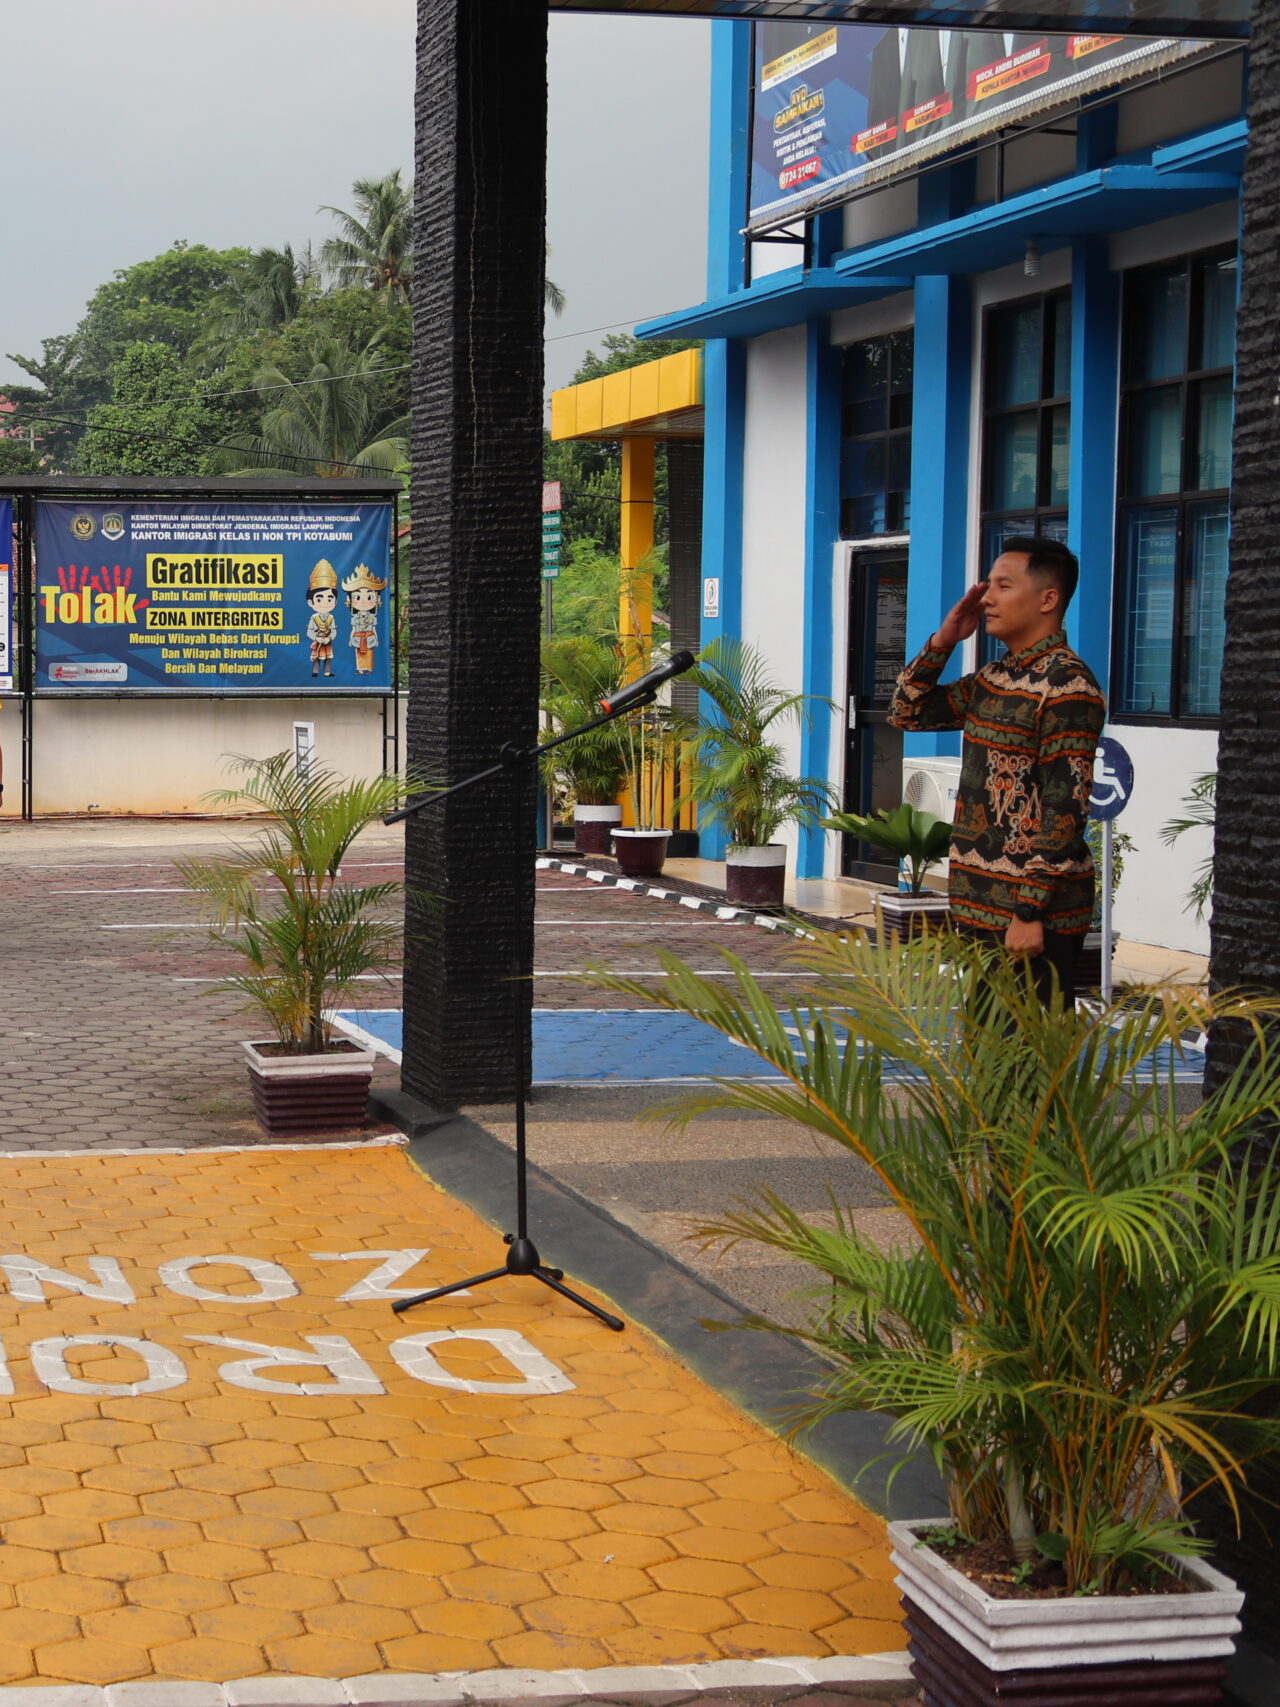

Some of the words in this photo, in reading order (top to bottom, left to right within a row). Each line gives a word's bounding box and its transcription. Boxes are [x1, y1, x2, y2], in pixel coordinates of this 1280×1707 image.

[791, 88, 807, 105] AYO
[781, 168, 797, 185] 0724
[131, 531, 172, 540] KANTOR
[173, 531, 217, 540] IMIGRASI
[219, 531, 251, 540] KELAS
[253, 532, 260, 541] II
[262, 532, 284, 541] NON
[286, 532, 302, 541] TPI
[304, 532, 353, 541] KOTABUMI
[151, 557, 278, 585] Gratifikasi
[151, 590, 180, 602] Bantu
[182, 590, 207, 602] Kami
[209, 590, 282, 602] Mewujudkanya
[40, 585, 138, 624] Tolak
[149, 611, 187, 627] ZONA
[191, 611, 280, 627] INTERGRITAS
[129, 633, 166, 645] Menuju
[168, 633, 207, 645] Wilayah
[209, 633, 239, 644] Bebas
[241, 633, 261, 644] Dari
[263, 633, 300, 645] Korupsi
[161, 648, 180, 659] Dan
[183, 648, 222, 660] Wilayah
[223, 648, 268, 659] Birokrasi
[165, 663, 196, 674] Bersih
[198, 663, 217, 674] Dan
[219, 663, 263, 675] Melayani
